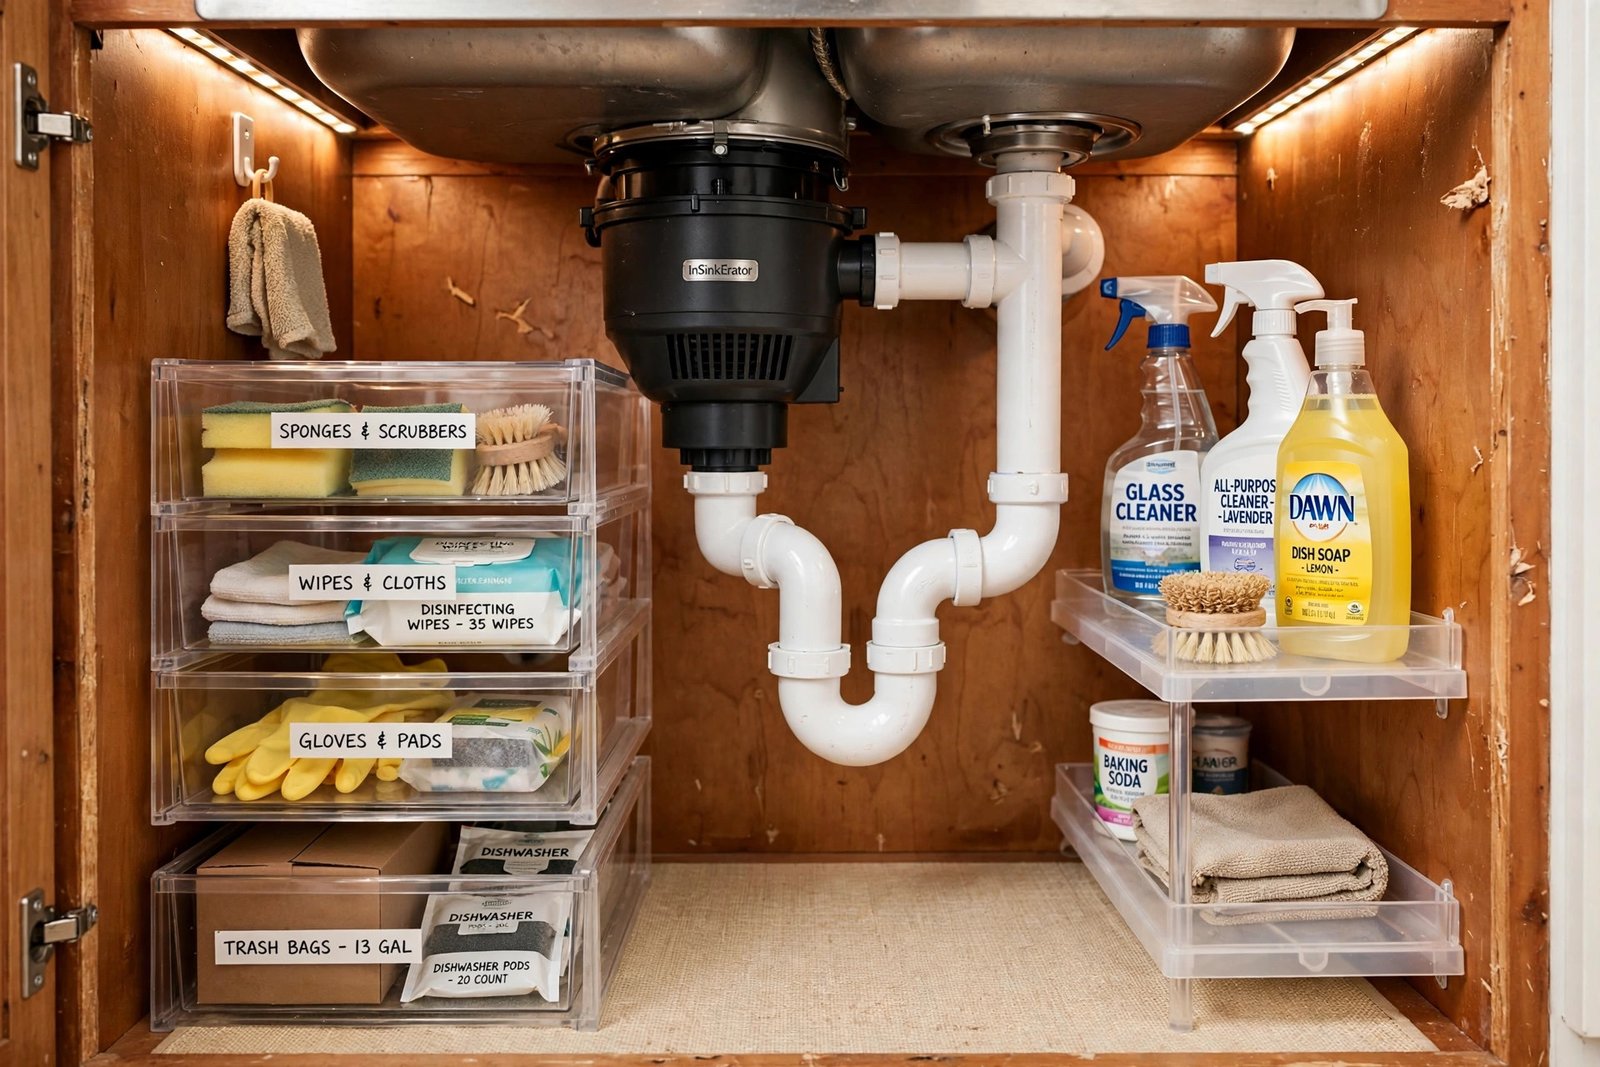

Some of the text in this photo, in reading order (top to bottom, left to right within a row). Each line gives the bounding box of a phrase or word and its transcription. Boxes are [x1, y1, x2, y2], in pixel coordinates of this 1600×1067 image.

[688, 264, 753, 276] InSinkErator
[279, 422, 467, 441] SPONGES & SCRUBBERS
[1125, 483, 1185, 502] GLASS
[1214, 479, 1276, 493] ALL-PURPOS
[1115, 503, 1198, 522] CLEANER
[1289, 494, 1355, 522] DAWN
[1291, 546, 1351, 563] DISH SOAP
[1306, 564, 1334, 575] LEMON
[298, 575, 353, 591] WIPES
[363, 573, 372, 592] &
[382, 576, 446, 591] CLOTHS
[420, 604, 515, 616] DISINFECTING
[407, 619, 450, 631] WIPES
[469, 619, 486, 631] 35
[491, 618, 534, 630] WIPES
[299, 731, 442, 751] GLOVES & PADS
[1104, 754, 1148, 774] BAKING
[1108, 770, 1142, 788] SODA
[480, 847, 570, 858] DISHWASHER
[448, 911, 534, 922] DISHWASHER
[223, 941, 279, 956] TRASH
[287, 940, 331, 956] BAGS
[355, 940, 371, 955] 13
[378, 940, 413, 955] GAL
[432, 961, 530, 974] DISHWASHER PODS
[457, 975, 471, 985] 20
[473, 974, 509, 985] COUNT
